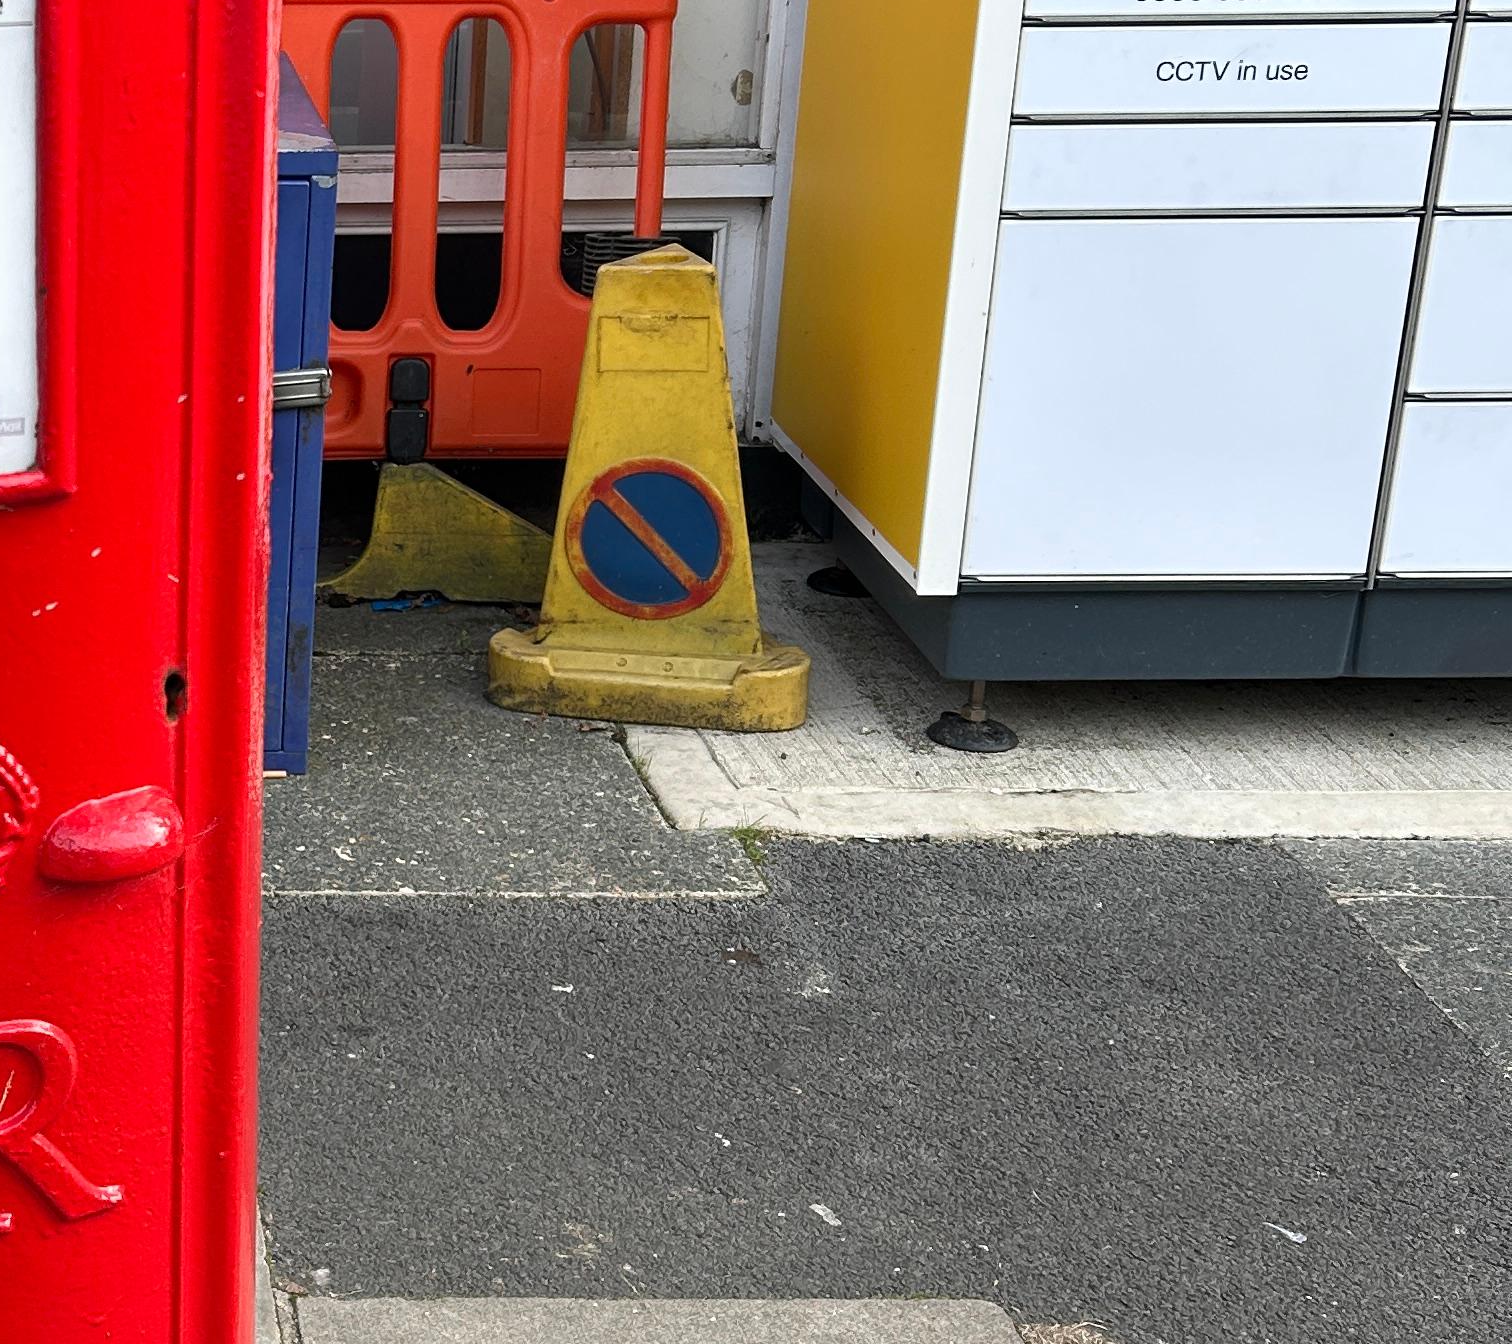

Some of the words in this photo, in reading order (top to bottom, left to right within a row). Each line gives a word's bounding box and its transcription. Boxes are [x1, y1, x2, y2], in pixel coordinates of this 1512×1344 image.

[1156, 61, 1230, 81] CCTV
[1237, 59, 1257, 80] in
[1266, 64, 1308, 80] use
